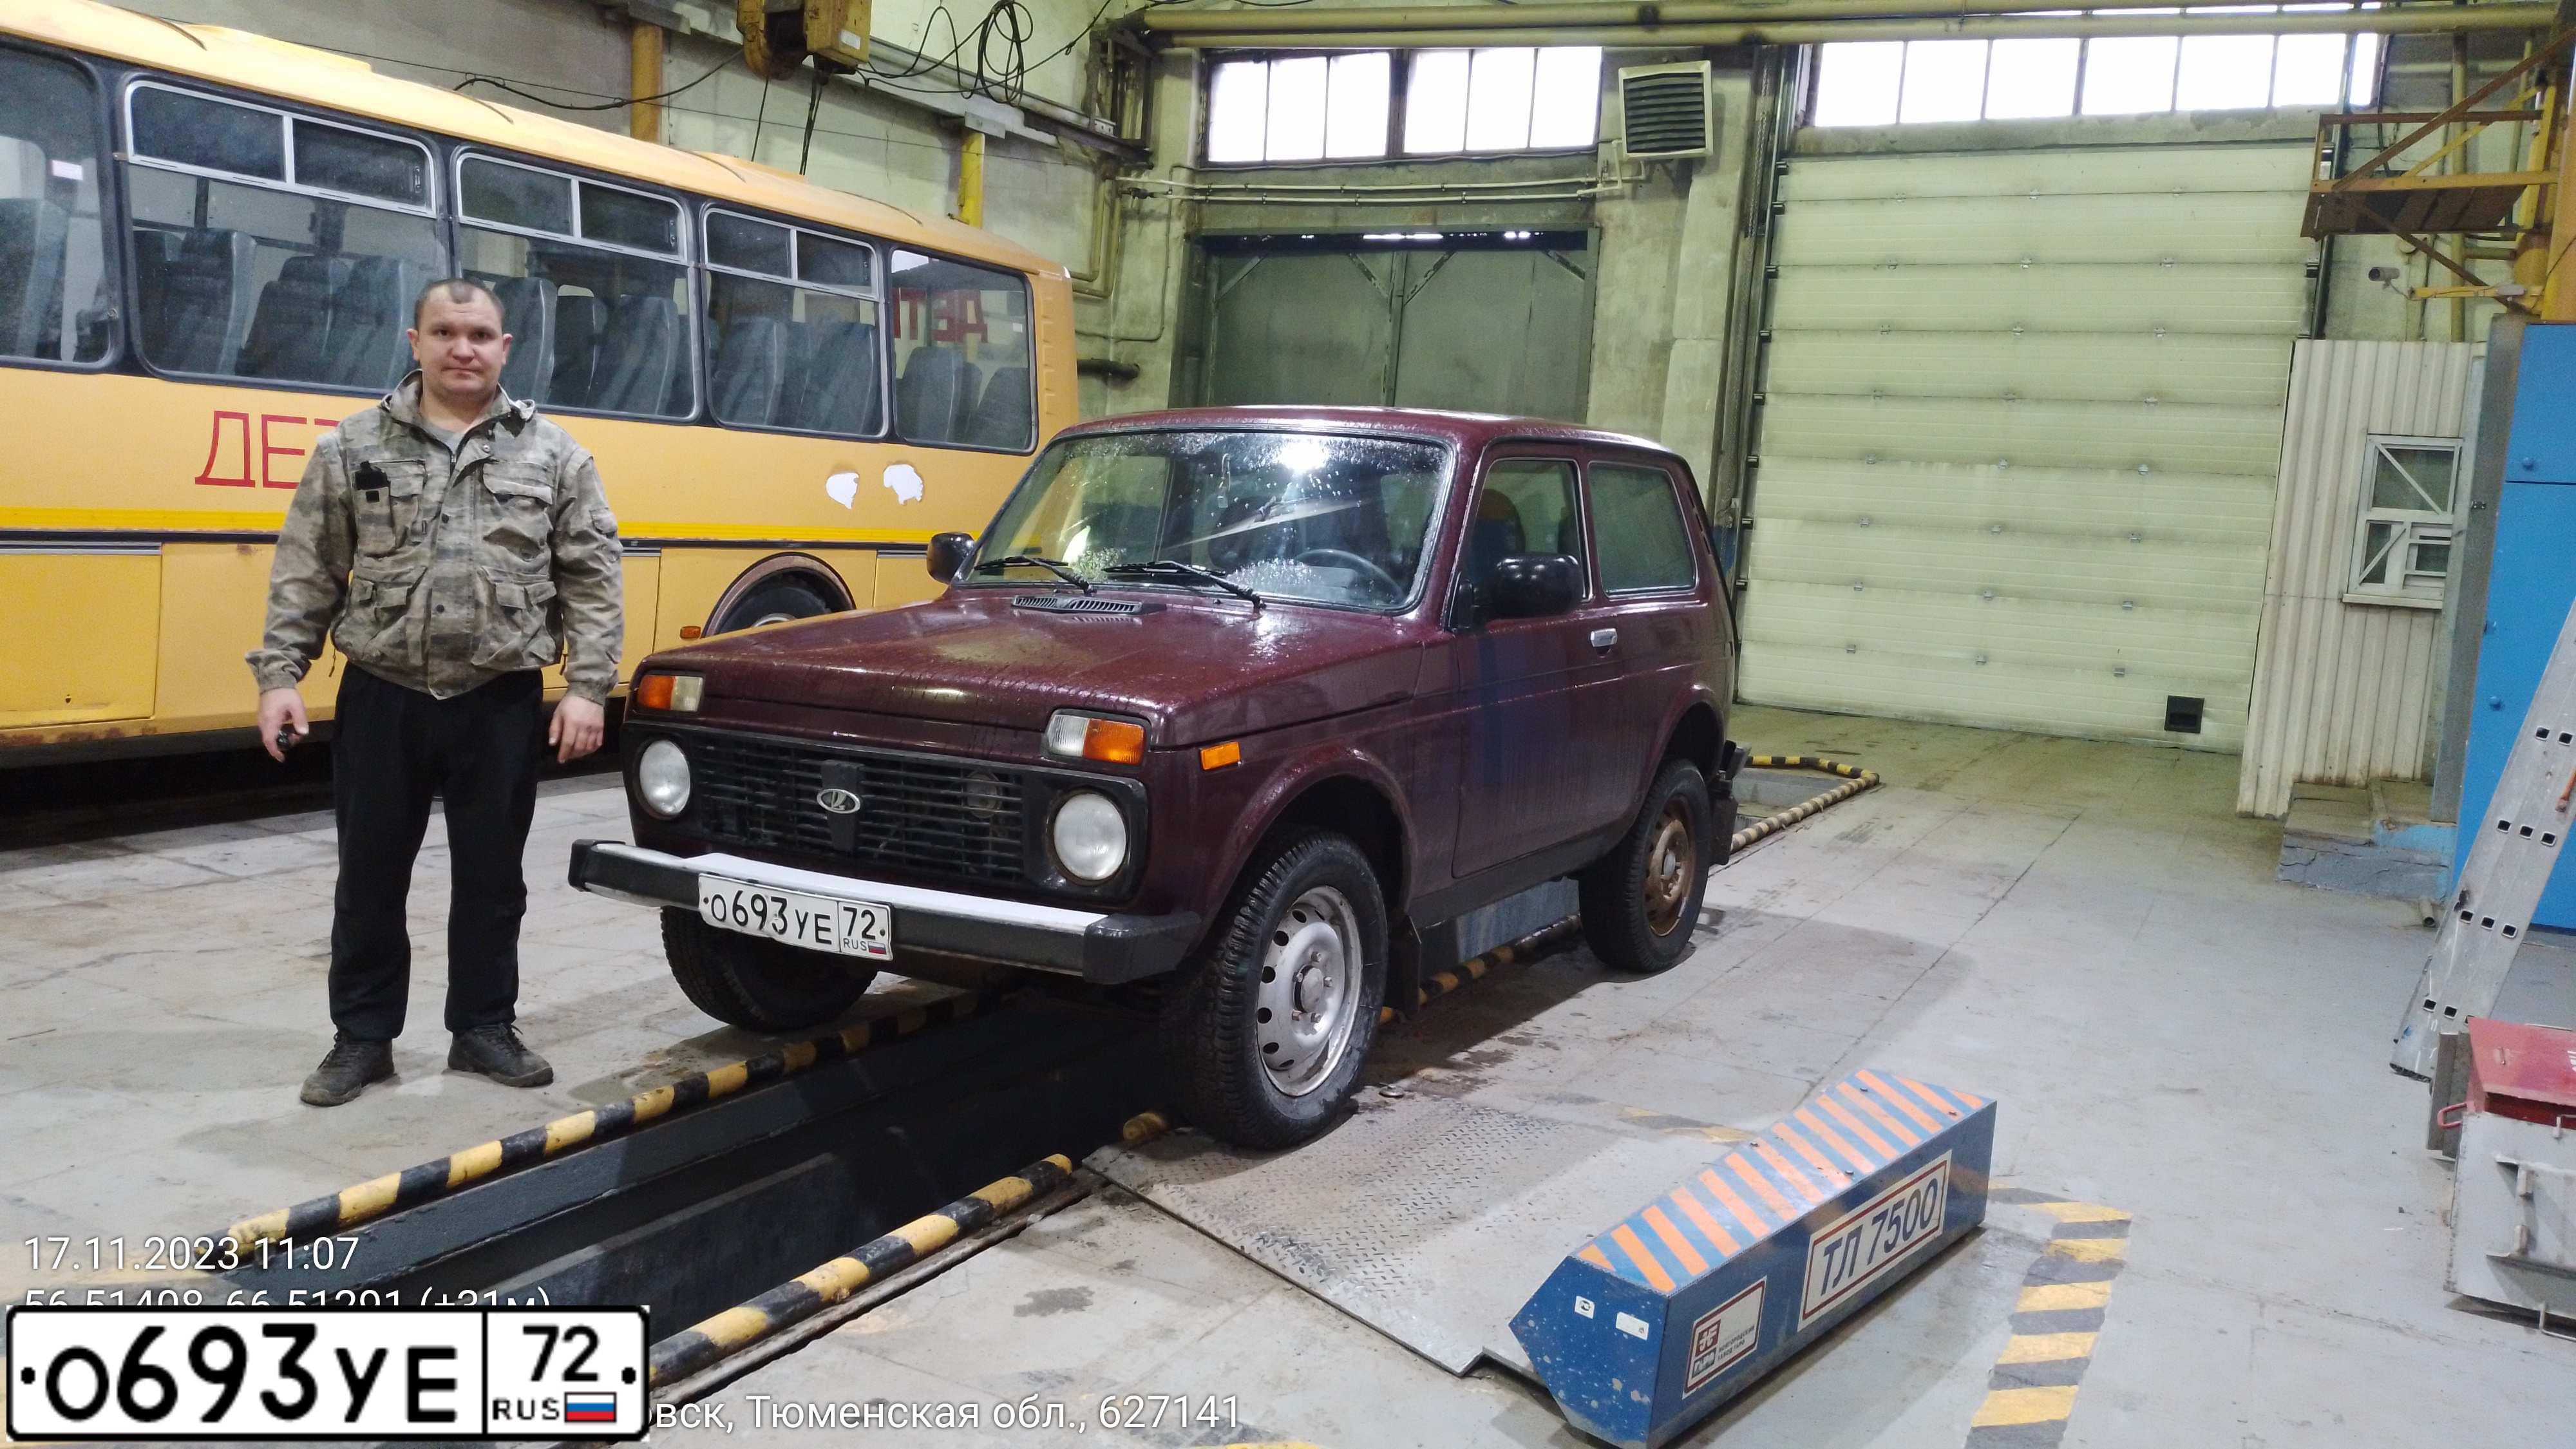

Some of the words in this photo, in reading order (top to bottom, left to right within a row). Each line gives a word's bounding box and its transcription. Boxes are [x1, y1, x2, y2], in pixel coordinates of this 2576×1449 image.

[710, 890, 832, 945] О693УЕ
[842, 906, 876, 940] 72
[842, 938, 867, 952] RUS
[1821, 1224, 1863, 1296] ТЛ
[1866, 1178, 1938, 1266] 7500
